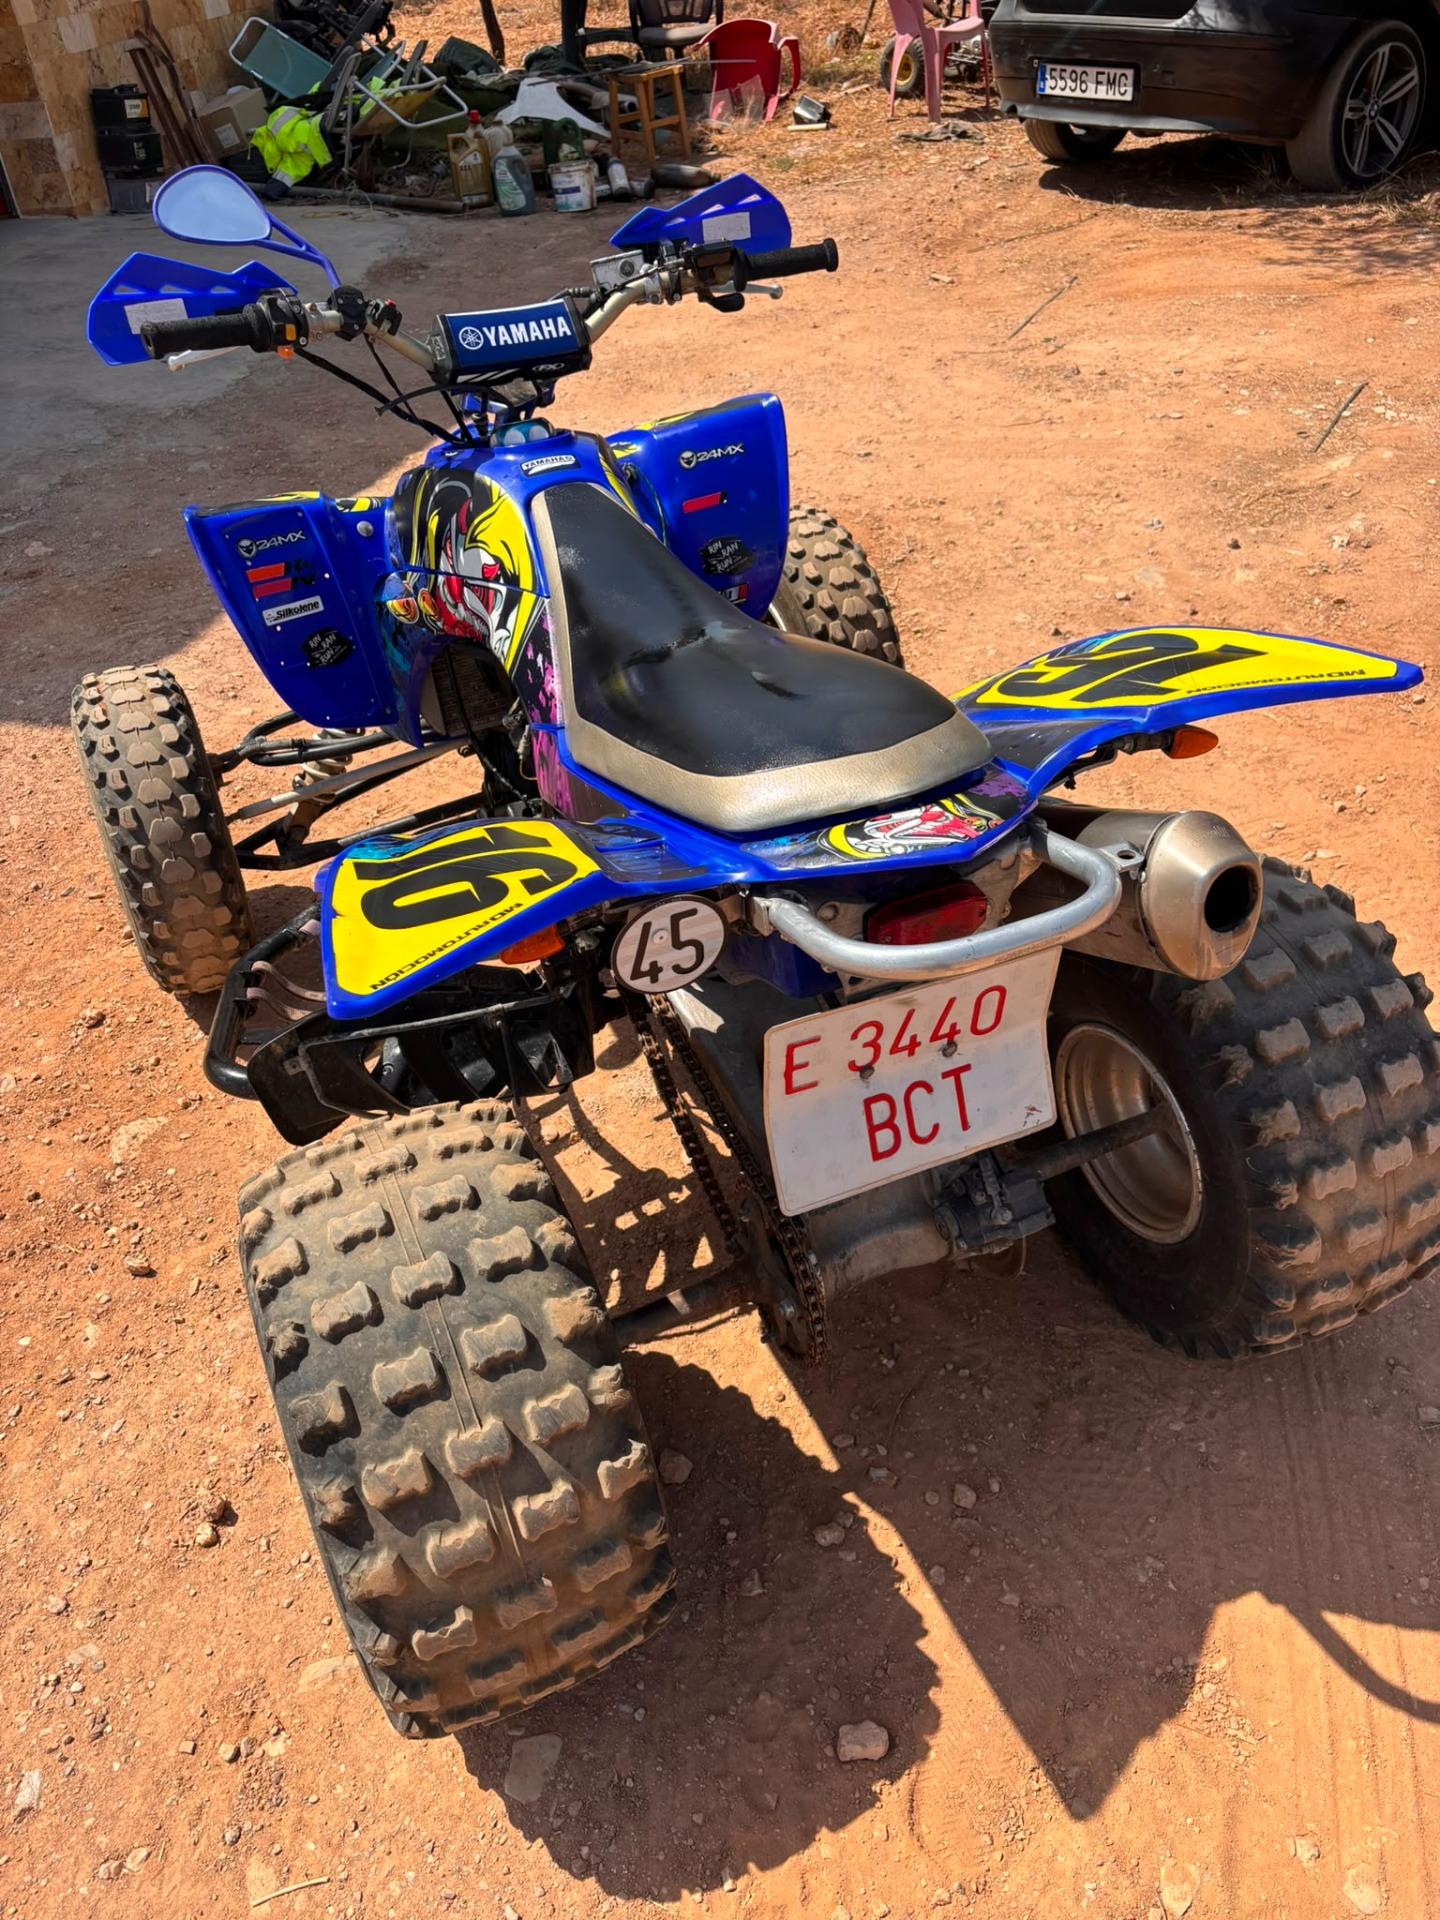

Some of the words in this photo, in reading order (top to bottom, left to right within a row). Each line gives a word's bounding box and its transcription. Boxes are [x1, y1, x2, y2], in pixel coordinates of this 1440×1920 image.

[1048, 67, 1089, 94] 5596
[482, 315, 572, 347] YAMAHA
[697, 443, 744, 461] 24MX
[256, 530, 306, 550] 24MX
[274, 600, 320, 620] Silkolene
[630, 907, 704, 984] 45
[783, 1035, 822, 1096] E
[847, 984, 1007, 1073] 3440
[863, 1063, 972, 1162] BCT
